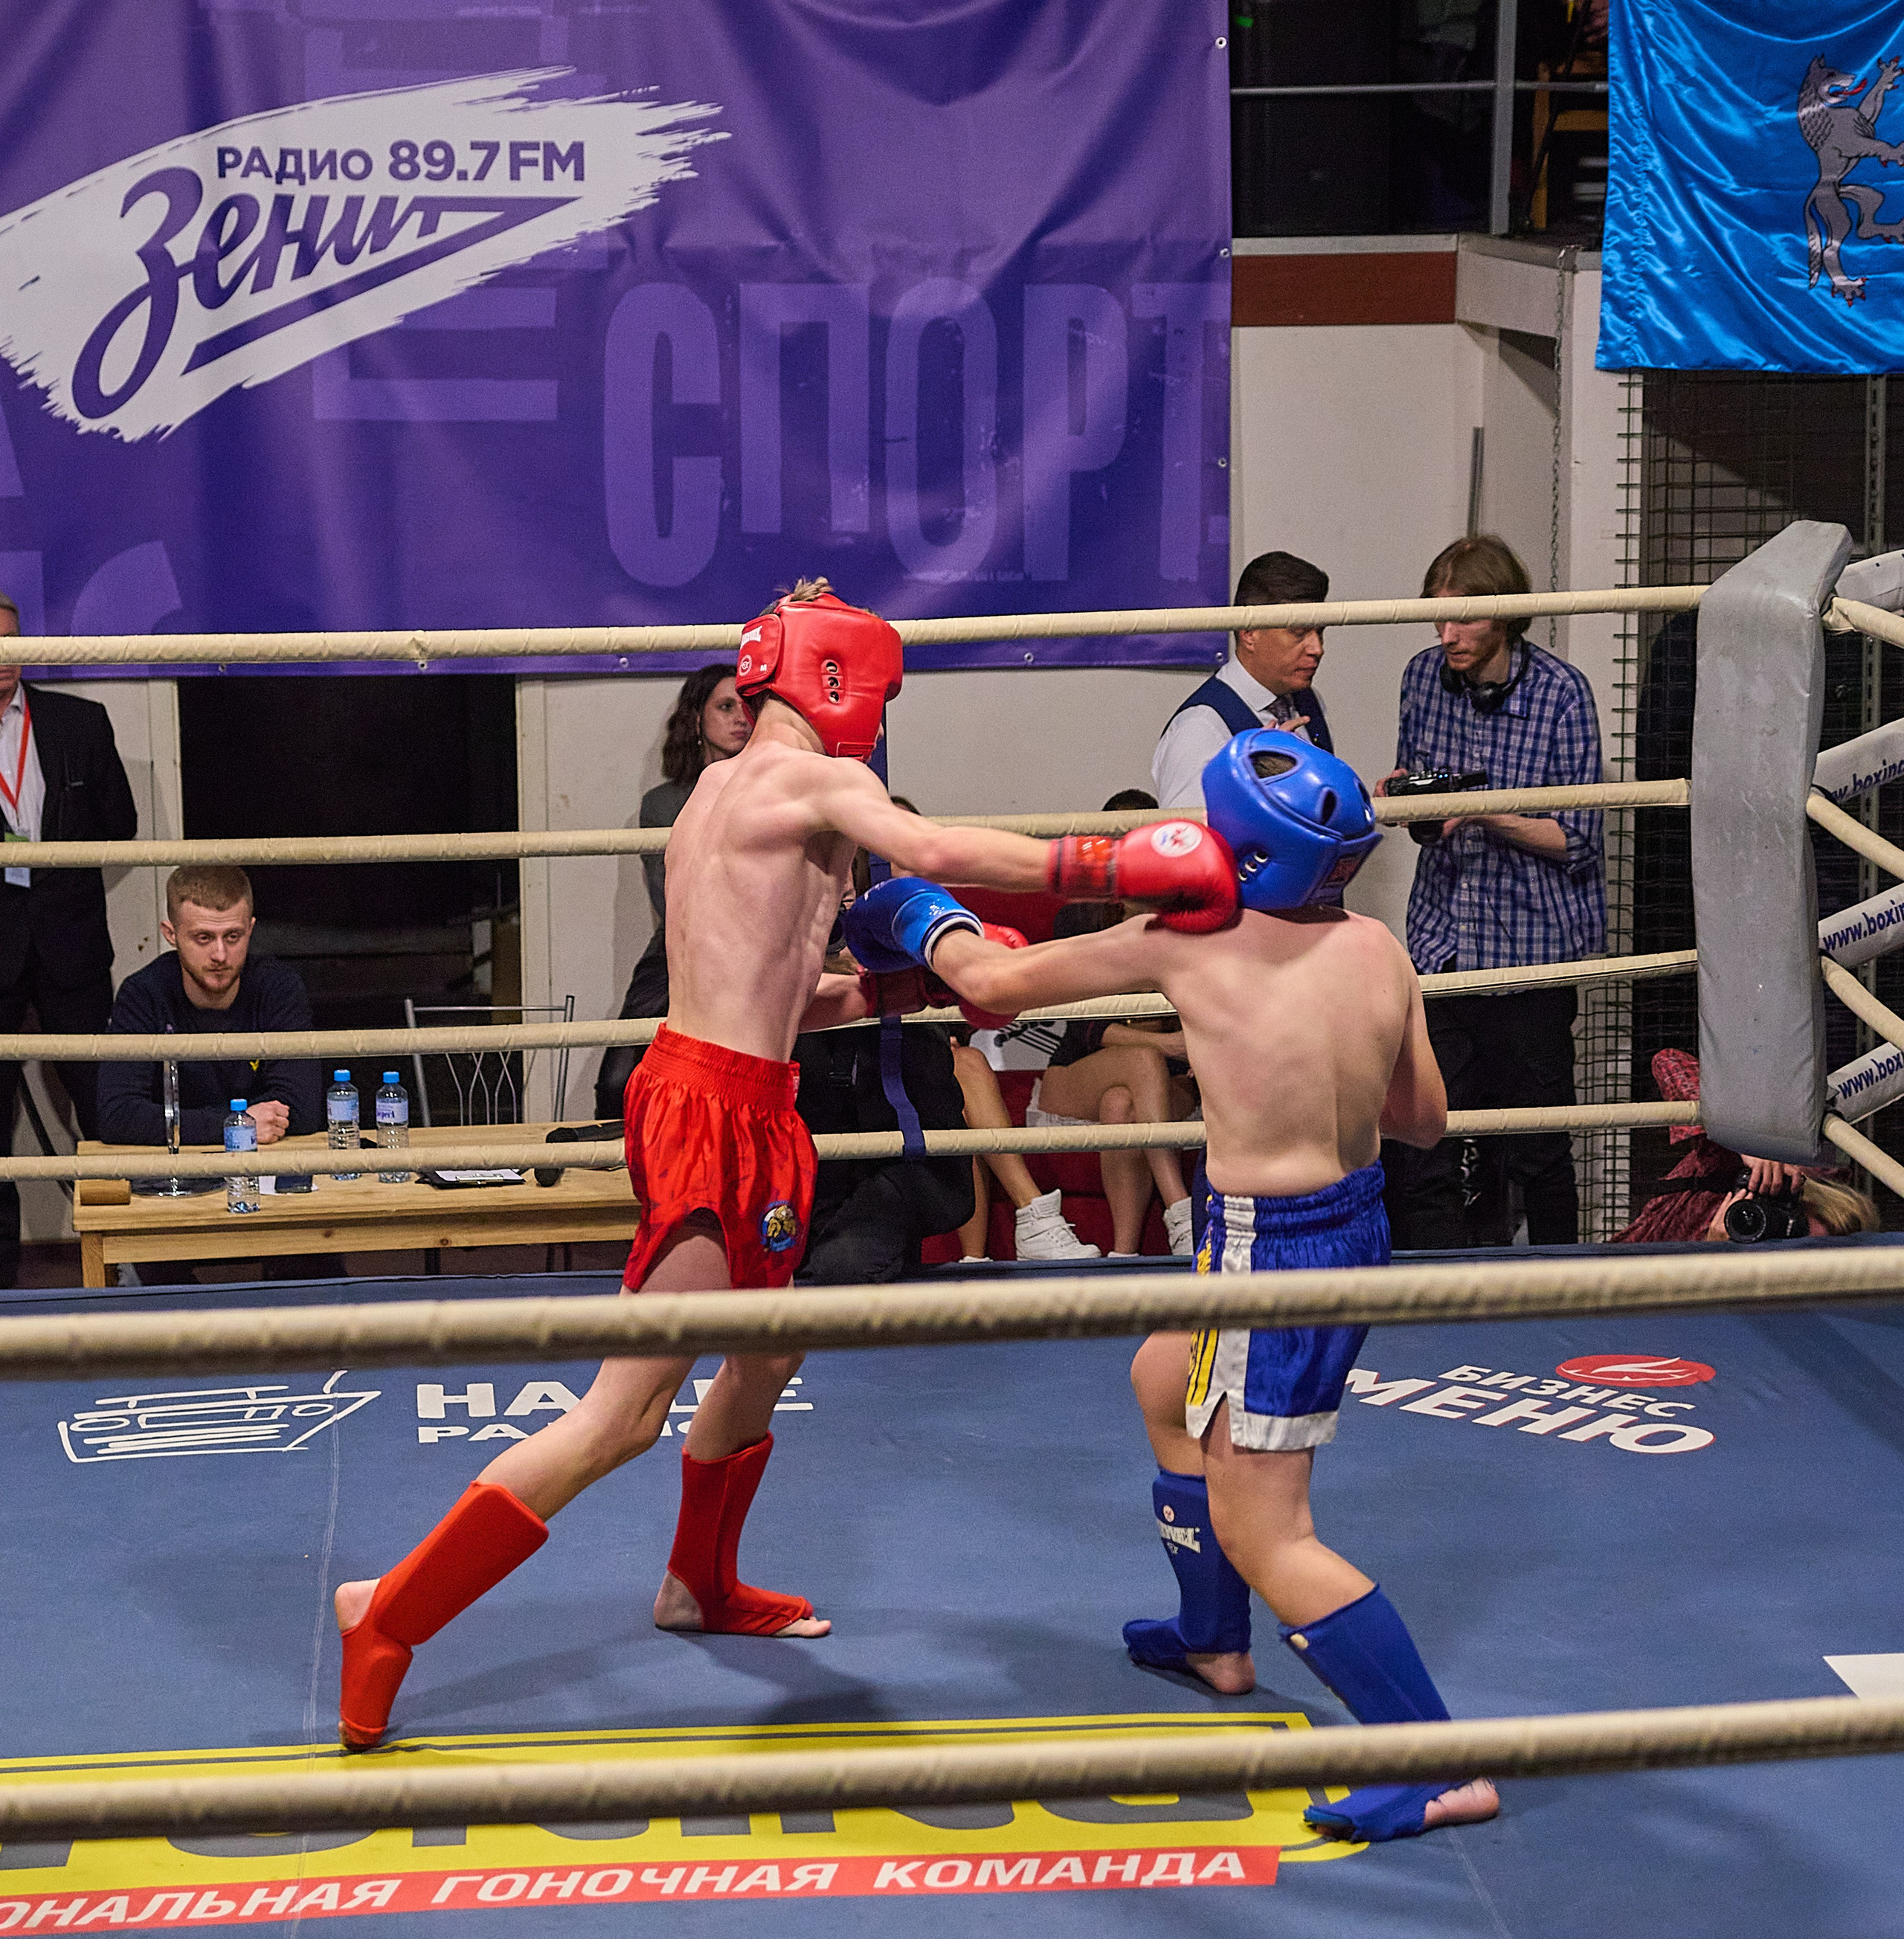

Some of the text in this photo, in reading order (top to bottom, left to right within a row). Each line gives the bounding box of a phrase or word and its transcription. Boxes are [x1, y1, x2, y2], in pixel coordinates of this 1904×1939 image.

[216, 140, 585, 187] РАДИО 89.7 FM
[71, 167, 584, 419] Зенит
[604, 279, 1230, 588] СПОРТ
[1345, 1368, 1716, 1454] МЕНЮ
[1438, 1364, 1696, 1418] БИЗНЕС
[431, 1862, 839, 1905] ГОНОЧНАЯ
[873, 1850, 1246, 1889] КОМАНДА
